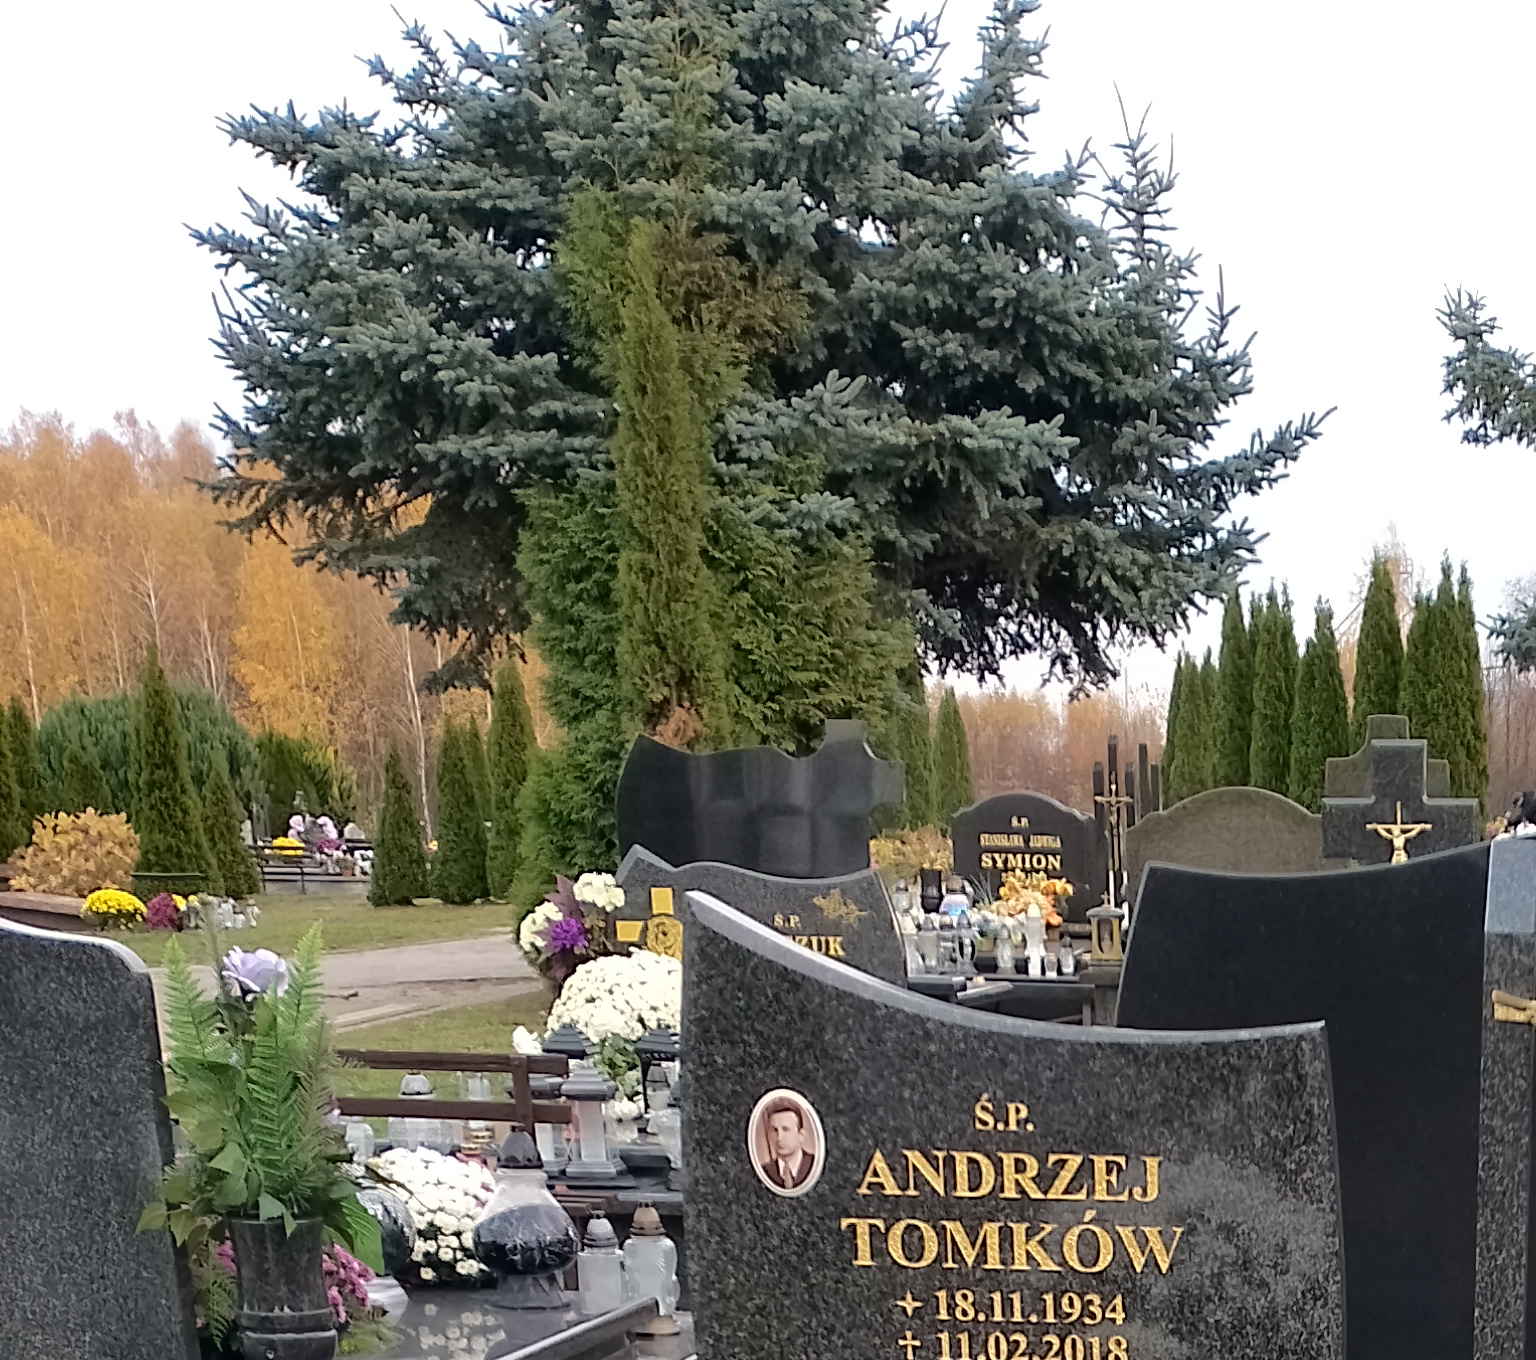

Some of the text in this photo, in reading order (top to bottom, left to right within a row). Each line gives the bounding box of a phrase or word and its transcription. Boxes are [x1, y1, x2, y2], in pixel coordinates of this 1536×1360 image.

[980, 852, 1062, 870] SYMION
[773, 911, 802, 928] Ś.P.
[974, 1092, 1035, 1132] Ś.P.
[856, 1148, 1165, 1203] ANDRZEJ
[839, 1208, 1185, 1275] TOMKÓW
[934, 1288, 1126, 1325] 18.11.1934
